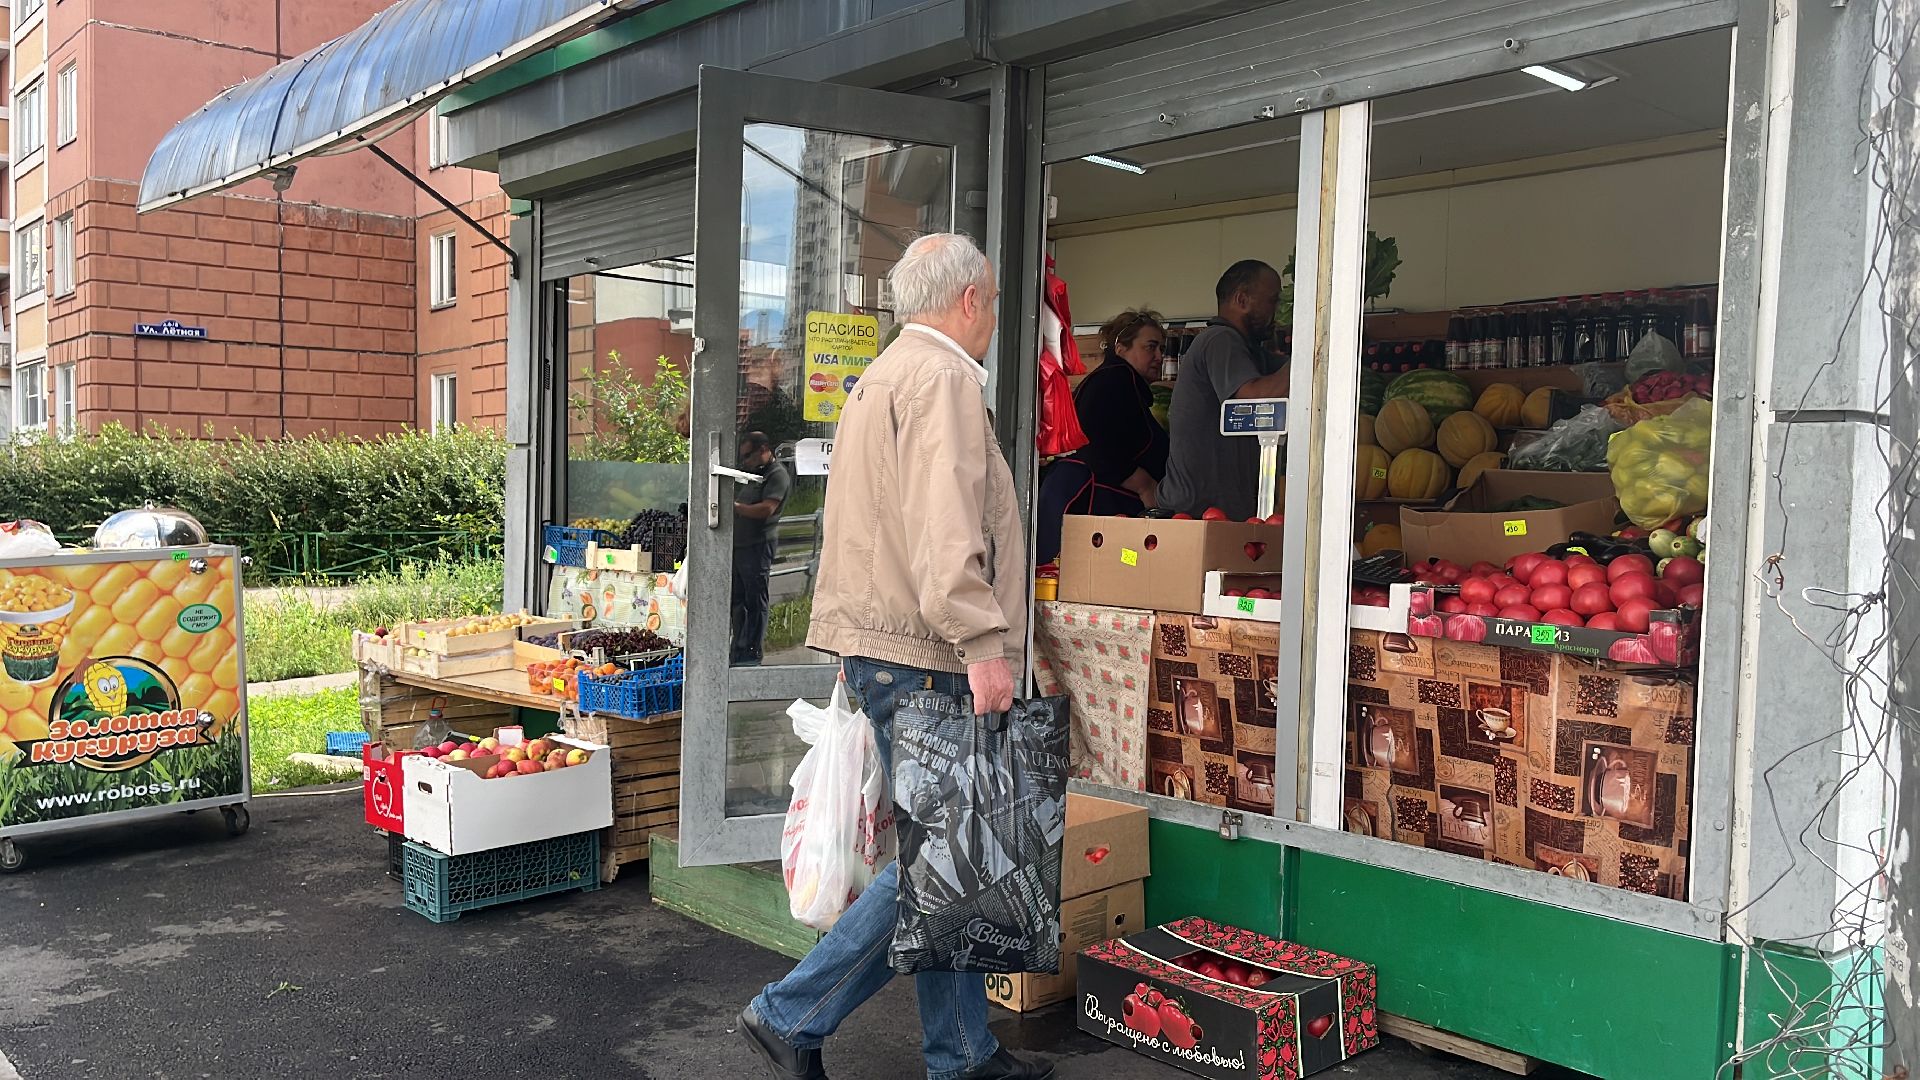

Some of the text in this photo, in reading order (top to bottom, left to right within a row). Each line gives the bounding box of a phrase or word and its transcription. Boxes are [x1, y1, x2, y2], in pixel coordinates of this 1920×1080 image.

[162, 327, 200, 337] Лётная
[808, 321, 876, 338] СПАСИБО
[813, 353, 839, 365] VISA
[841, 354, 873, 367] МИР
[182, 614, 218, 623] СОДЕРЖИТ
[1495, 623, 1571, 643] ПАРАЙЗ
[1554, 642, 1601, 657] Краснодар
[49, 708, 199, 741] Золотая
[902, 727, 959, 758] JAPONAIS
[37, 777, 201, 810] www.roboss.ru
[968, 919, 1031, 956] Bicycle
[1085, 993, 1246, 1070] Выращено с любовью!
